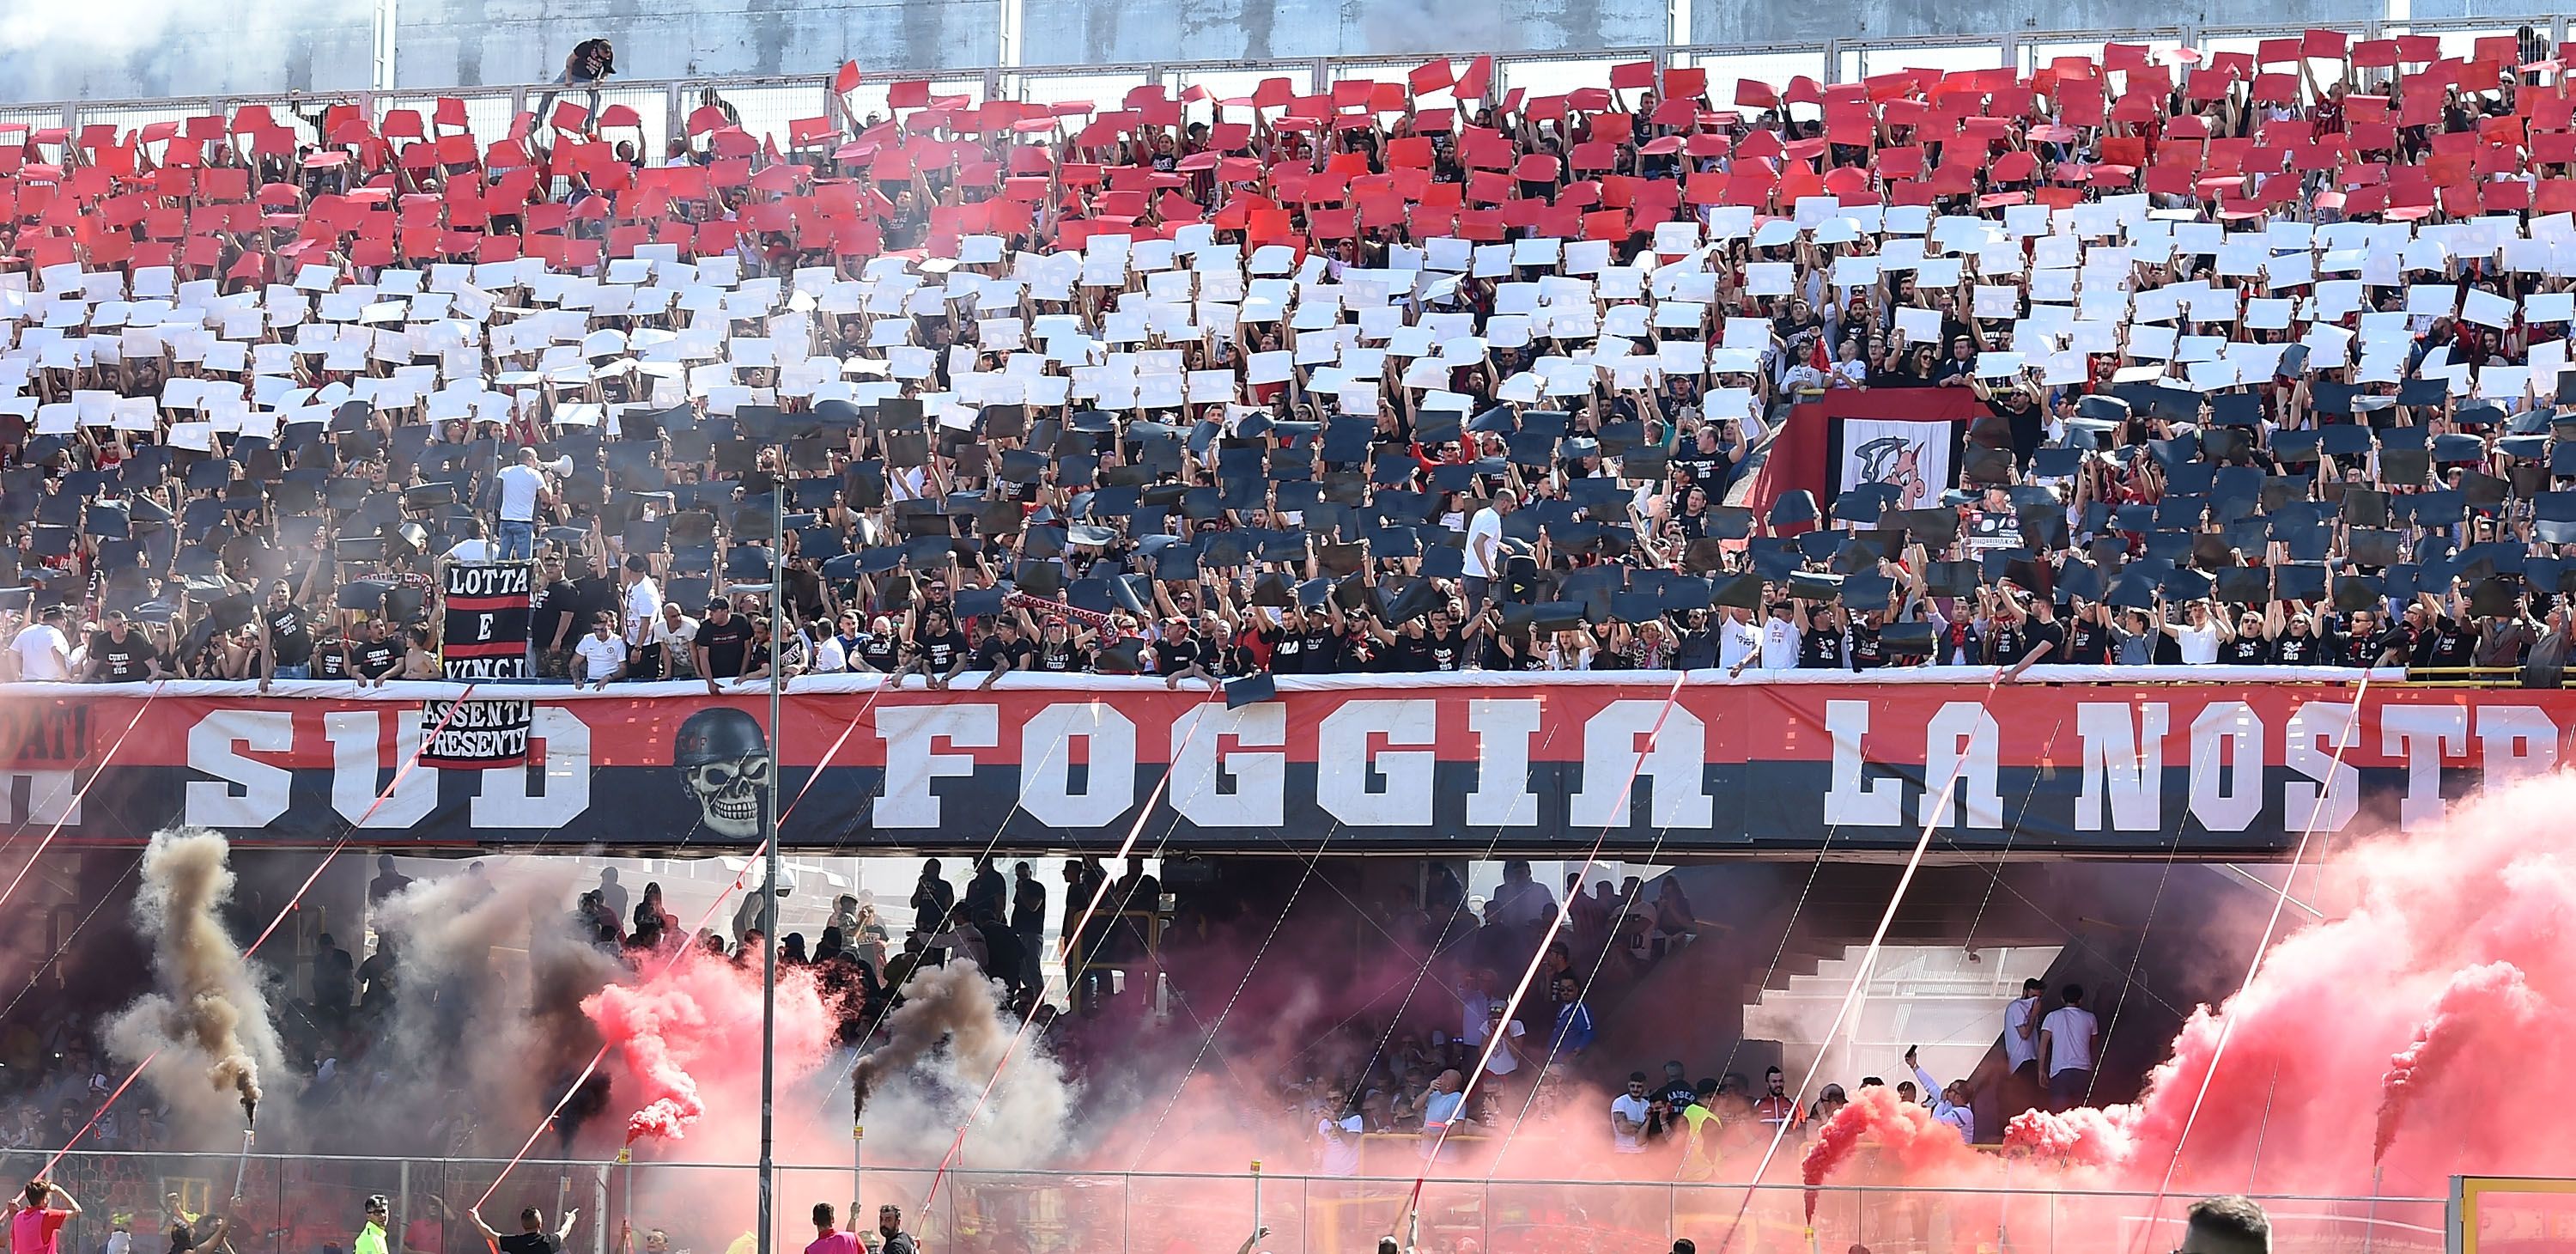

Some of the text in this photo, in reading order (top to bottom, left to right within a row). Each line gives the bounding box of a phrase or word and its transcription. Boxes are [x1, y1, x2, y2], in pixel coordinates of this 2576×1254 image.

[450, 568, 529, 594] LOTTA
[275, 612, 295, 627] CURVA
[283, 625, 297, 636] SUD
[477, 613, 494, 641] E
[367, 648, 390, 659] CURVA
[113, 667, 128, 675] SUD
[445, 658, 525, 679] VINCI
[422, 700, 532, 727] ASSENTI
[419, 726, 529, 758] PRESENTI
[185, 705, 591, 828] SUD
[872, 698, 1714, 828] FOGGIA
[1824, 699, 2004, 830] LA
